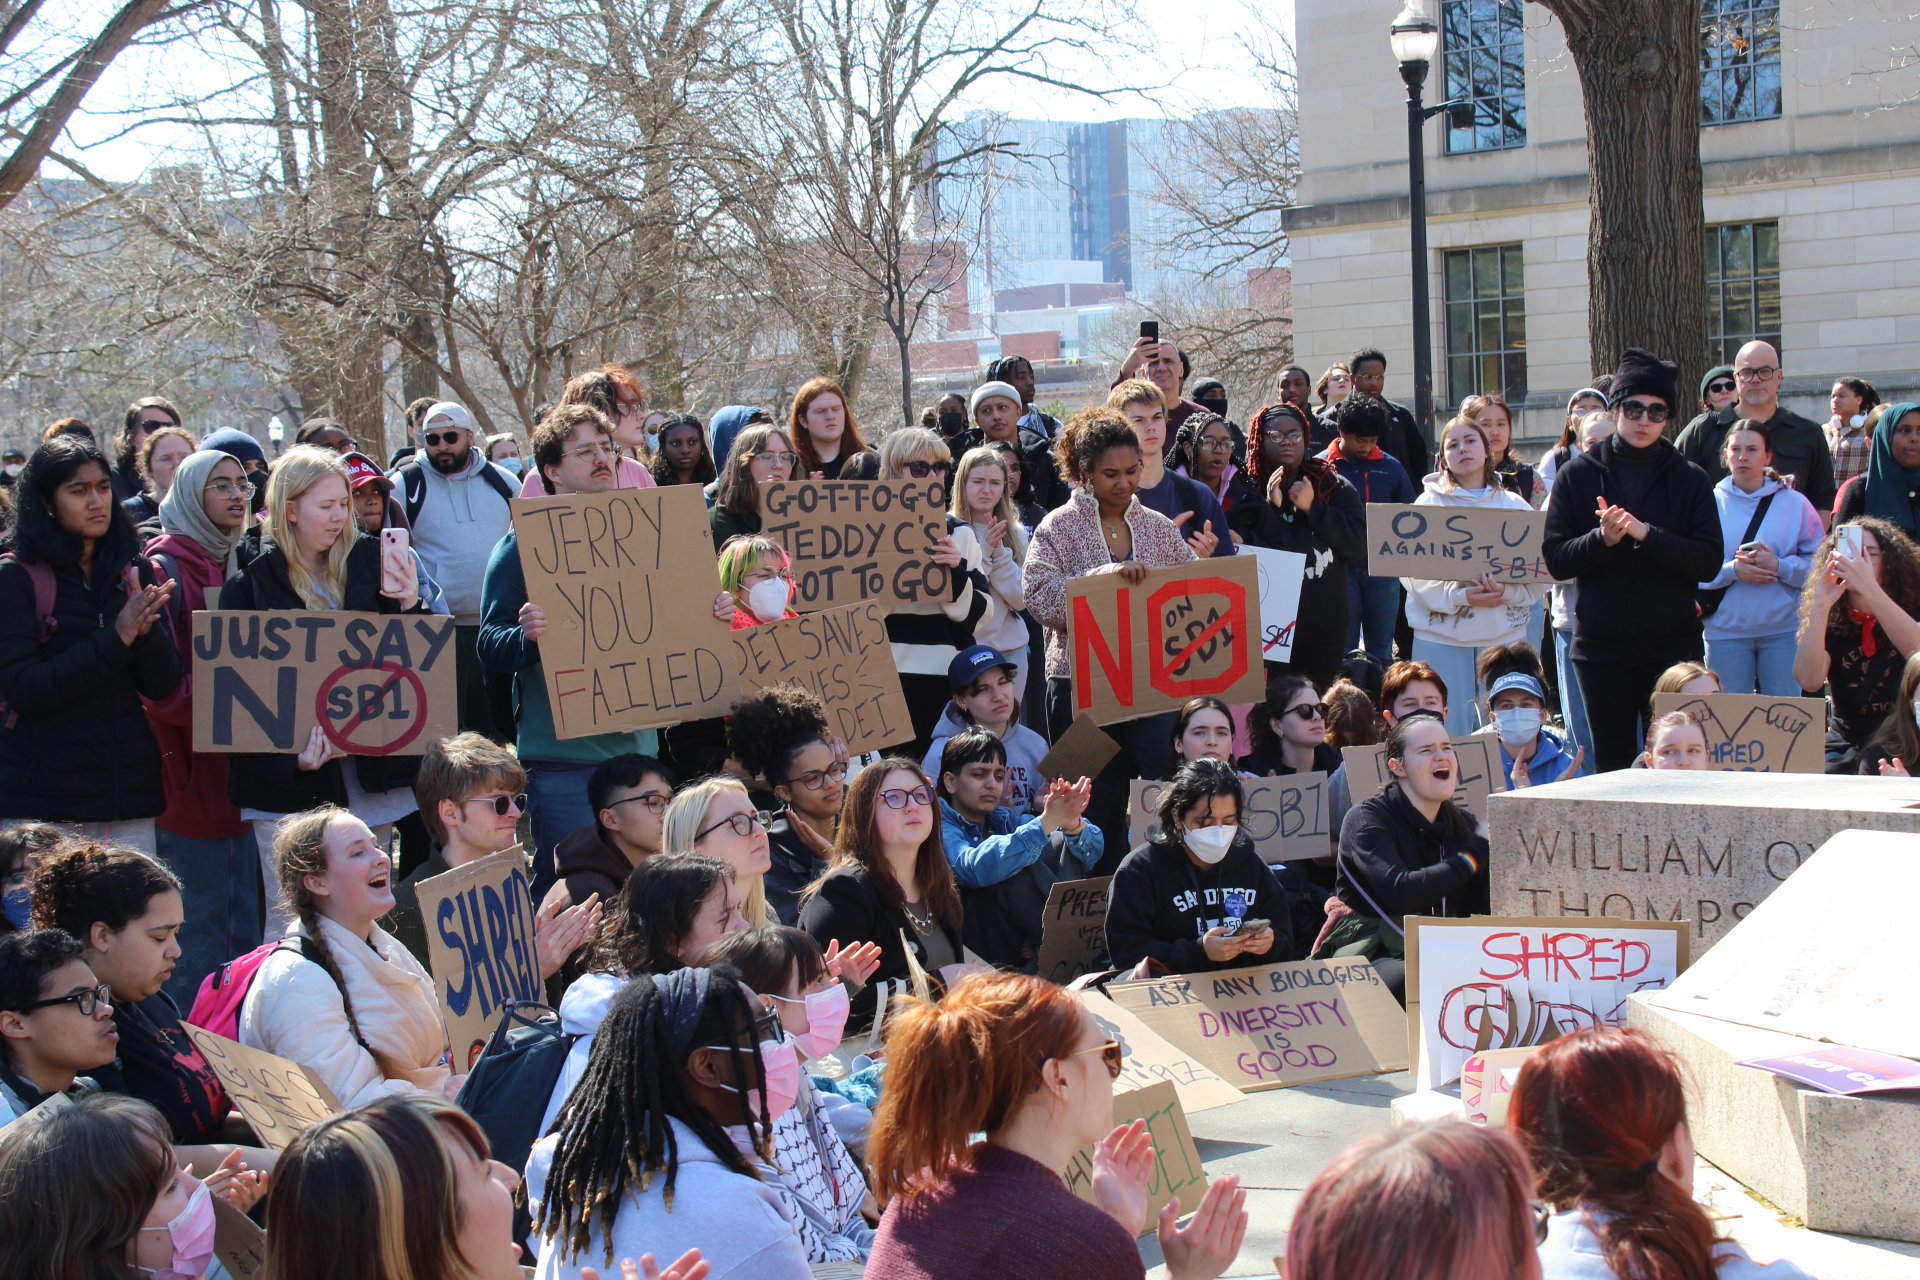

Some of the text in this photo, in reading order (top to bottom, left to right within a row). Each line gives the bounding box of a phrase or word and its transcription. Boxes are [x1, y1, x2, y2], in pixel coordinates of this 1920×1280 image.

[521, 496, 662, 574] JERRY
[768, 515, 941, 560] TEDDY C'S
[1378, 541, 1494, 560] AGAINST
[893, 559, 947, 602] GO
[556, 574, 653, 664] YOU
[799, 604, 885, 660] SAVES
[1165, 595, 1193, 628] ON
[194, 615, 456, 672] JUST SAY
[1262, 625, 1291, 648] SB1
[325, 679, 410, 722] SB1
[555, 648, 723, 732] FAILED
[837, 693, 895, 744] DEI
[1709, 740, 1765, 764] HRED
[1248, 782, 1328, 841] SB1
[1516, 828, 1734, 878] WILLIAM
[437, 867, 541, 1022] SHRED
[1479, 932, 1651, 982] SHRED
[1149, 964, 1379, 1007] ASK ANY BIOLOGIST,
[1199, 998, 1348, 1038] DIVERSITY
[1237, 1044, 1337, 1080] GOOD
[1264, 1032, 1292, 1050] IS
